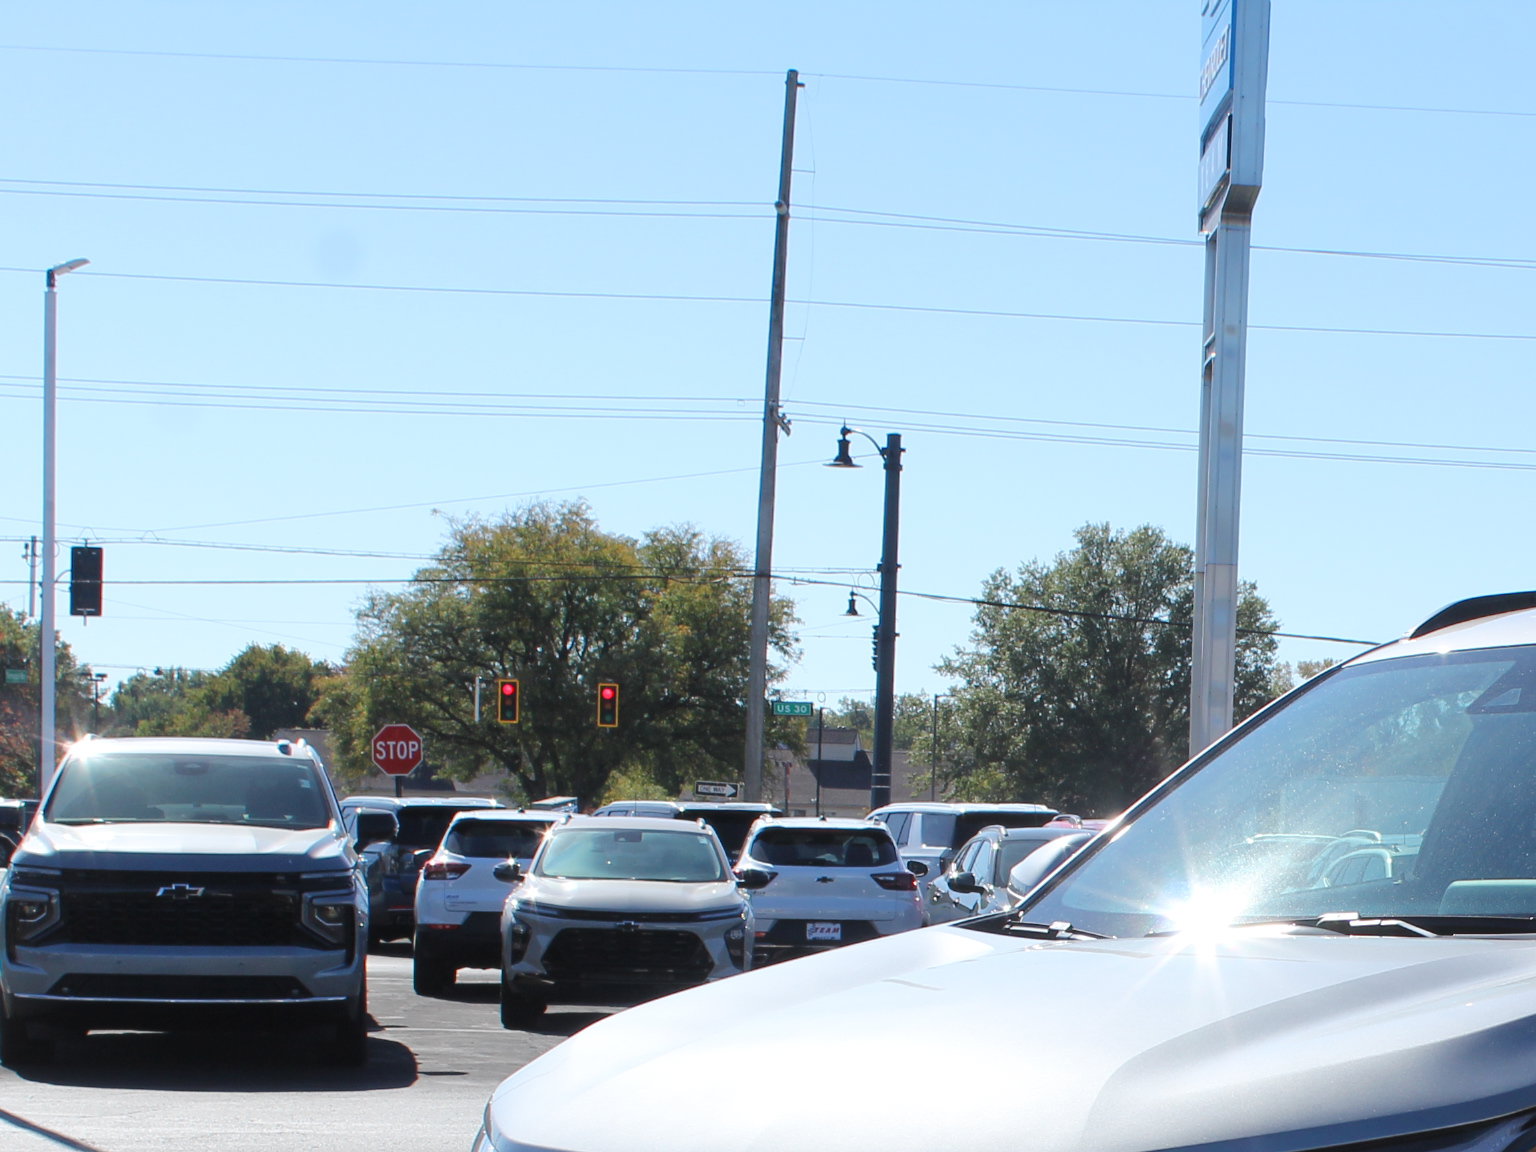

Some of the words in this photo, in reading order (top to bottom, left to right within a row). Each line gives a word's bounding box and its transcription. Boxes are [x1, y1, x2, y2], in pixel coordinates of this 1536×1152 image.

[777, 704, 791, 713] US
[794, 705, 808, 713] 30
[376, 741, 419, 760] STOP
